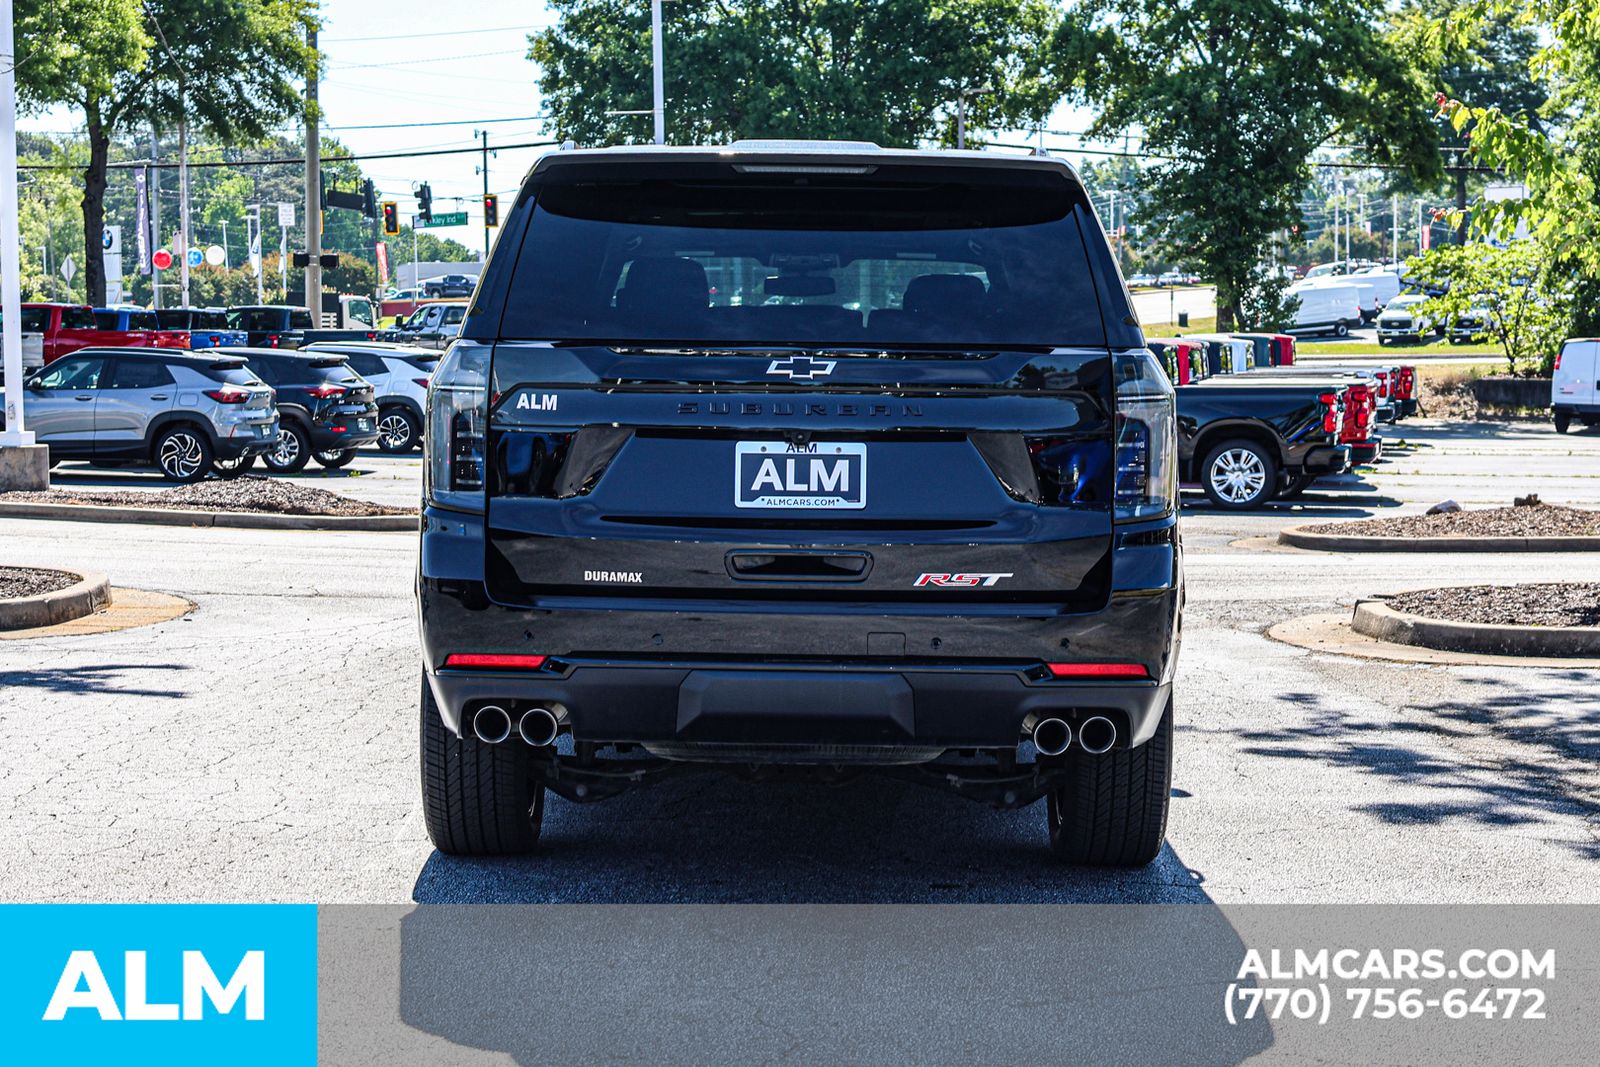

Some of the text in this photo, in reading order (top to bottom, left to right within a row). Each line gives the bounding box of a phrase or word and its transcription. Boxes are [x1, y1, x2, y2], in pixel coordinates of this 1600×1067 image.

[516, 393, 558, 411] ALM
[677, 402, 923, 416] SUBURBAN
[786, 442, 817, 453] ALM
[750, 458, 850, 492] ALM
[766, 498, 836, 507] ALMCARS.COM
[584, 570, 643, 583] DURAMAX
[913, 573, 1014, 586] RST
